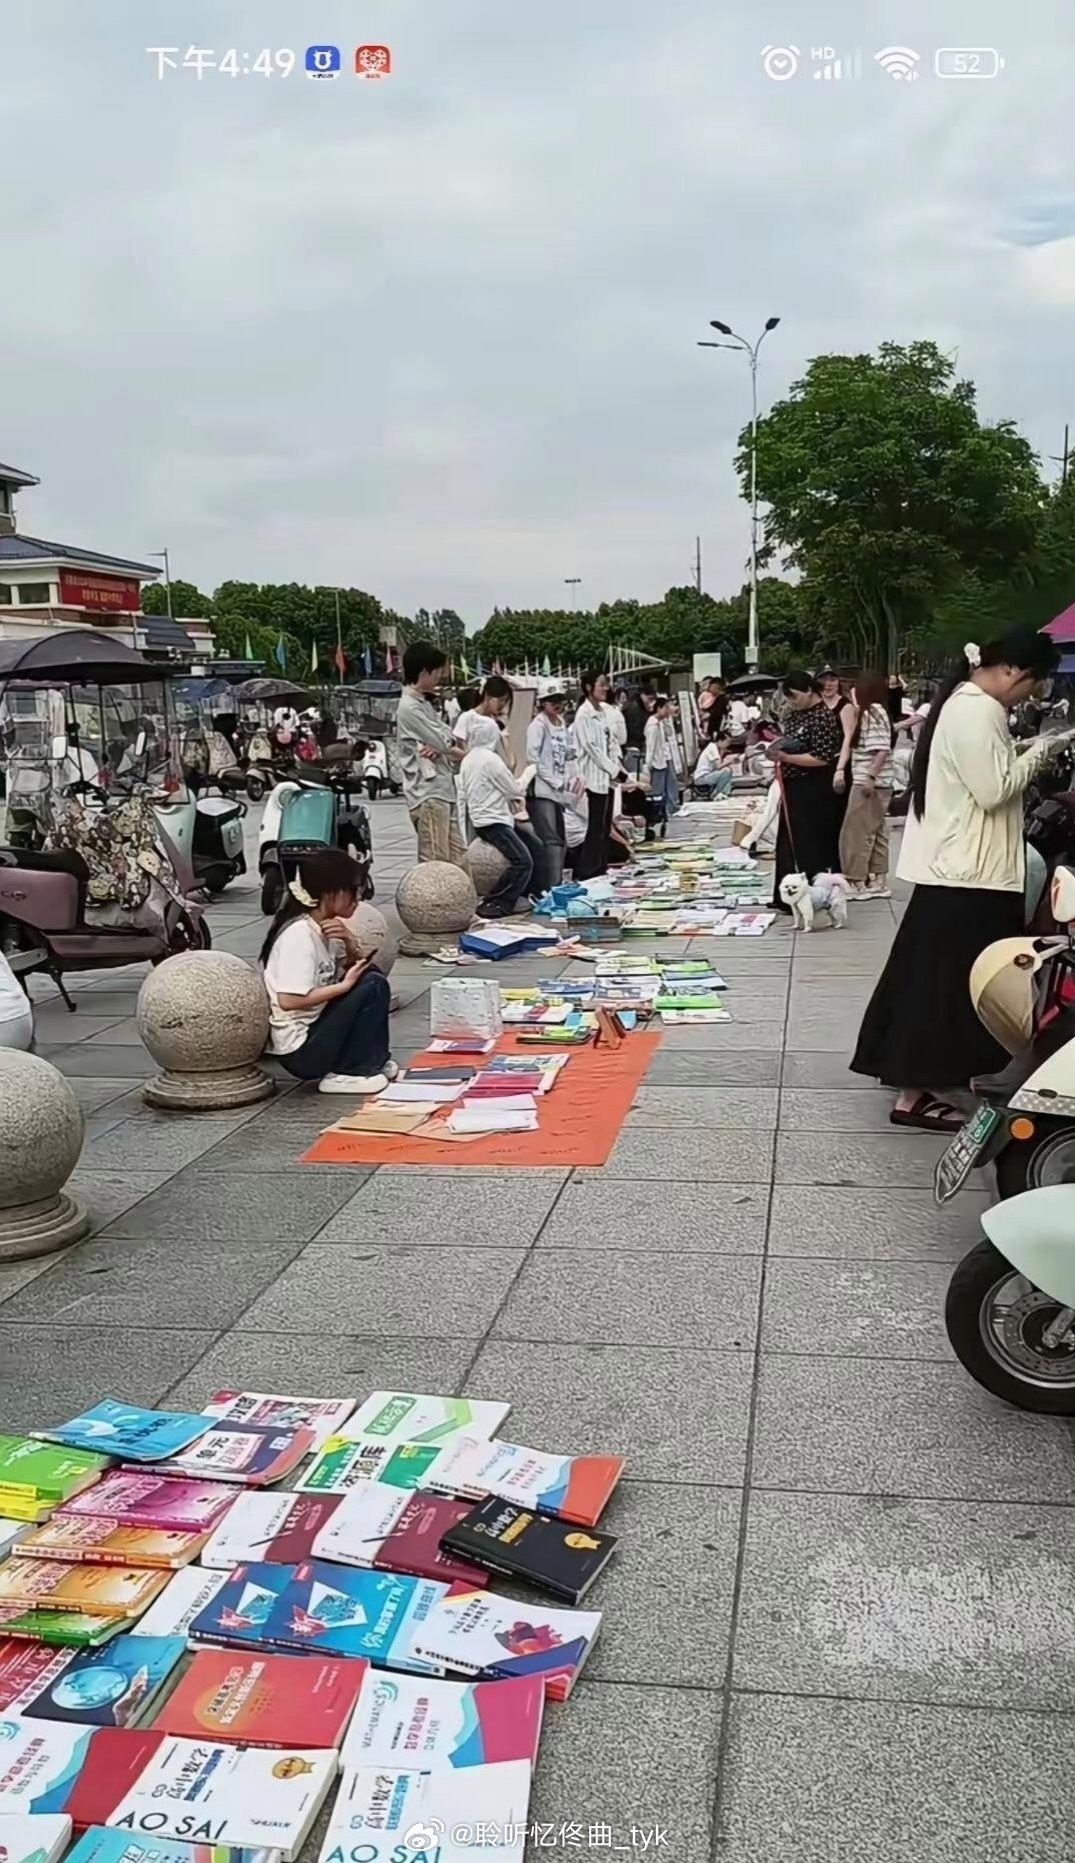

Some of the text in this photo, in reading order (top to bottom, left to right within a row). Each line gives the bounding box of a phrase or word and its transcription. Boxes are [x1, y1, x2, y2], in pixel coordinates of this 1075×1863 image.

[115, 1810, 228, 1840] AO SAI
[326, 1844, 379, 1863] AO
